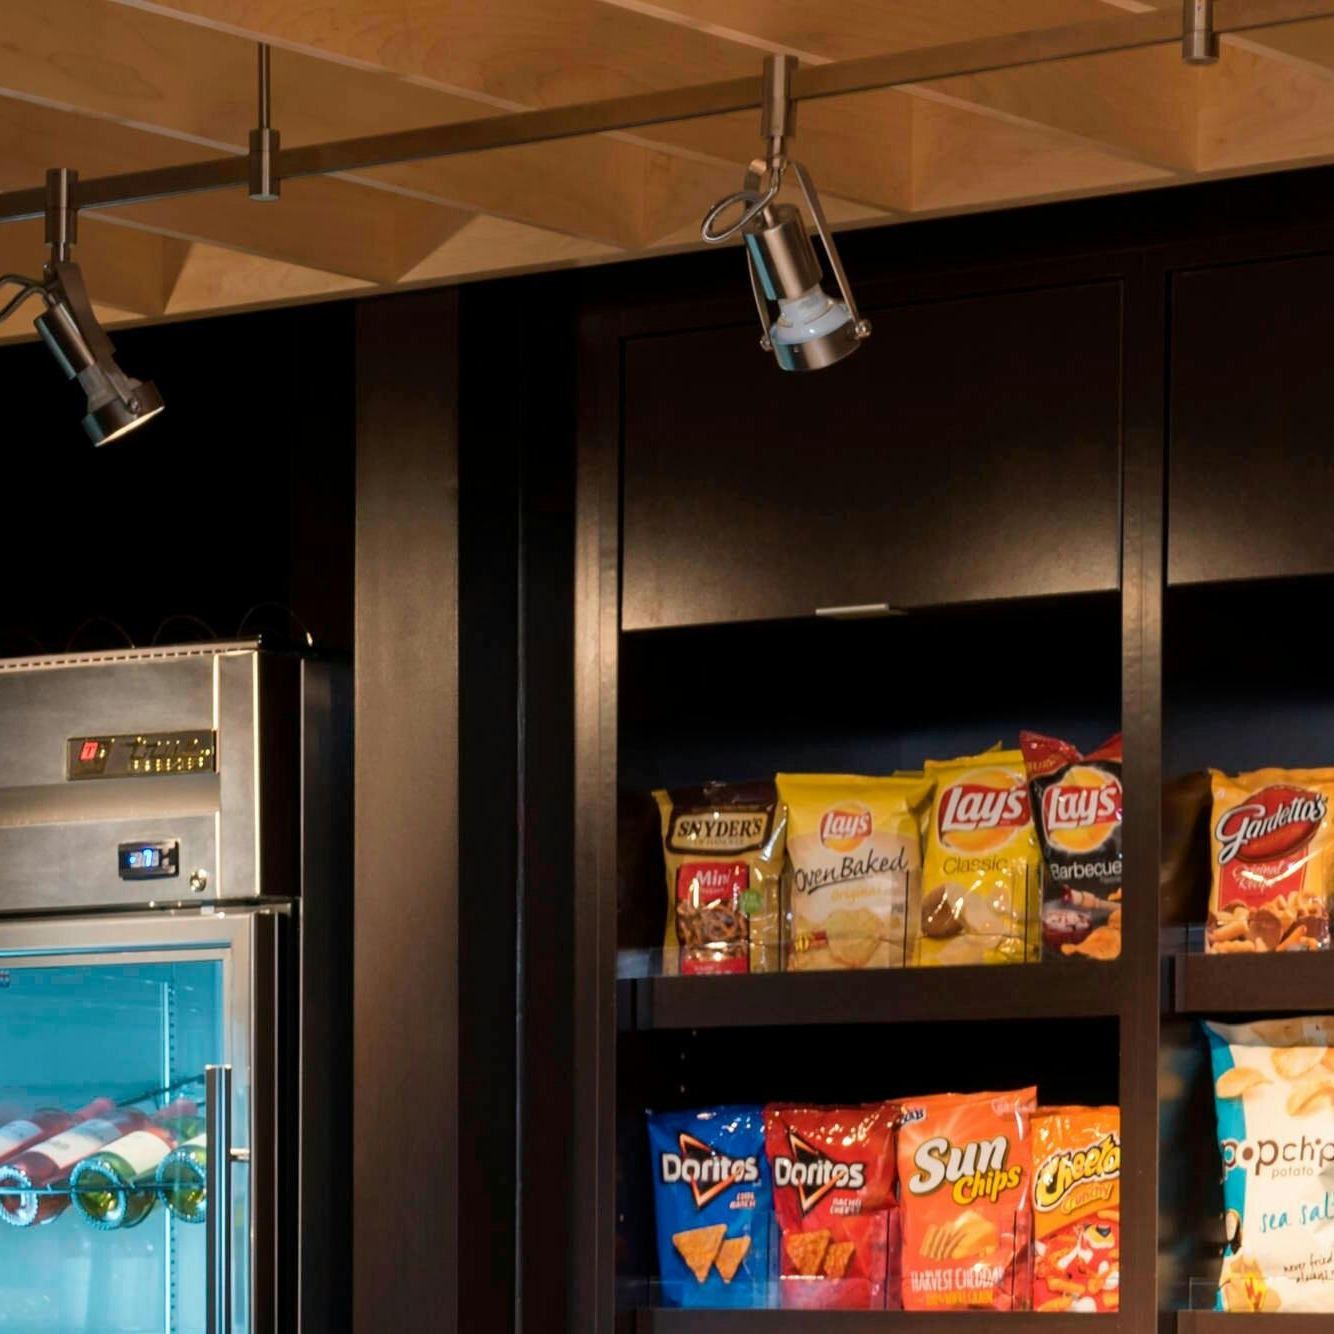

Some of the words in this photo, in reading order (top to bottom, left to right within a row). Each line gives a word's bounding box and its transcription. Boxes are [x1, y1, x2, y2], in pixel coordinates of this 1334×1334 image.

[941, 784, 1028, 832] Lay's
[1047, 783, 1117, 831] Lay's
[677, 817, 764, 838] SNYDER'S
[1216, 793, 1329, 864] Gardetto's
[794, 867, 839, 893] Oven
[840, 846, 909, 881] Baked
[942, 855, 1008, 875] Classic
[1050, 859, 1123, 880] Barbecue
[661, 1151, 759, 1184] Doritos
[774, 1156, 865, 1188] Doritos
[908, 1135, 1008, 1195] Sun
[1036, 1134, 1120, 1207] Cheeto
[1271, 1166, 1314, 1180] potato
[952, 1164, 1022, 1206] Chips
[1260, 1210, 1291, 1233] sea
[910, 1268, 953, 1293] HARVEST
